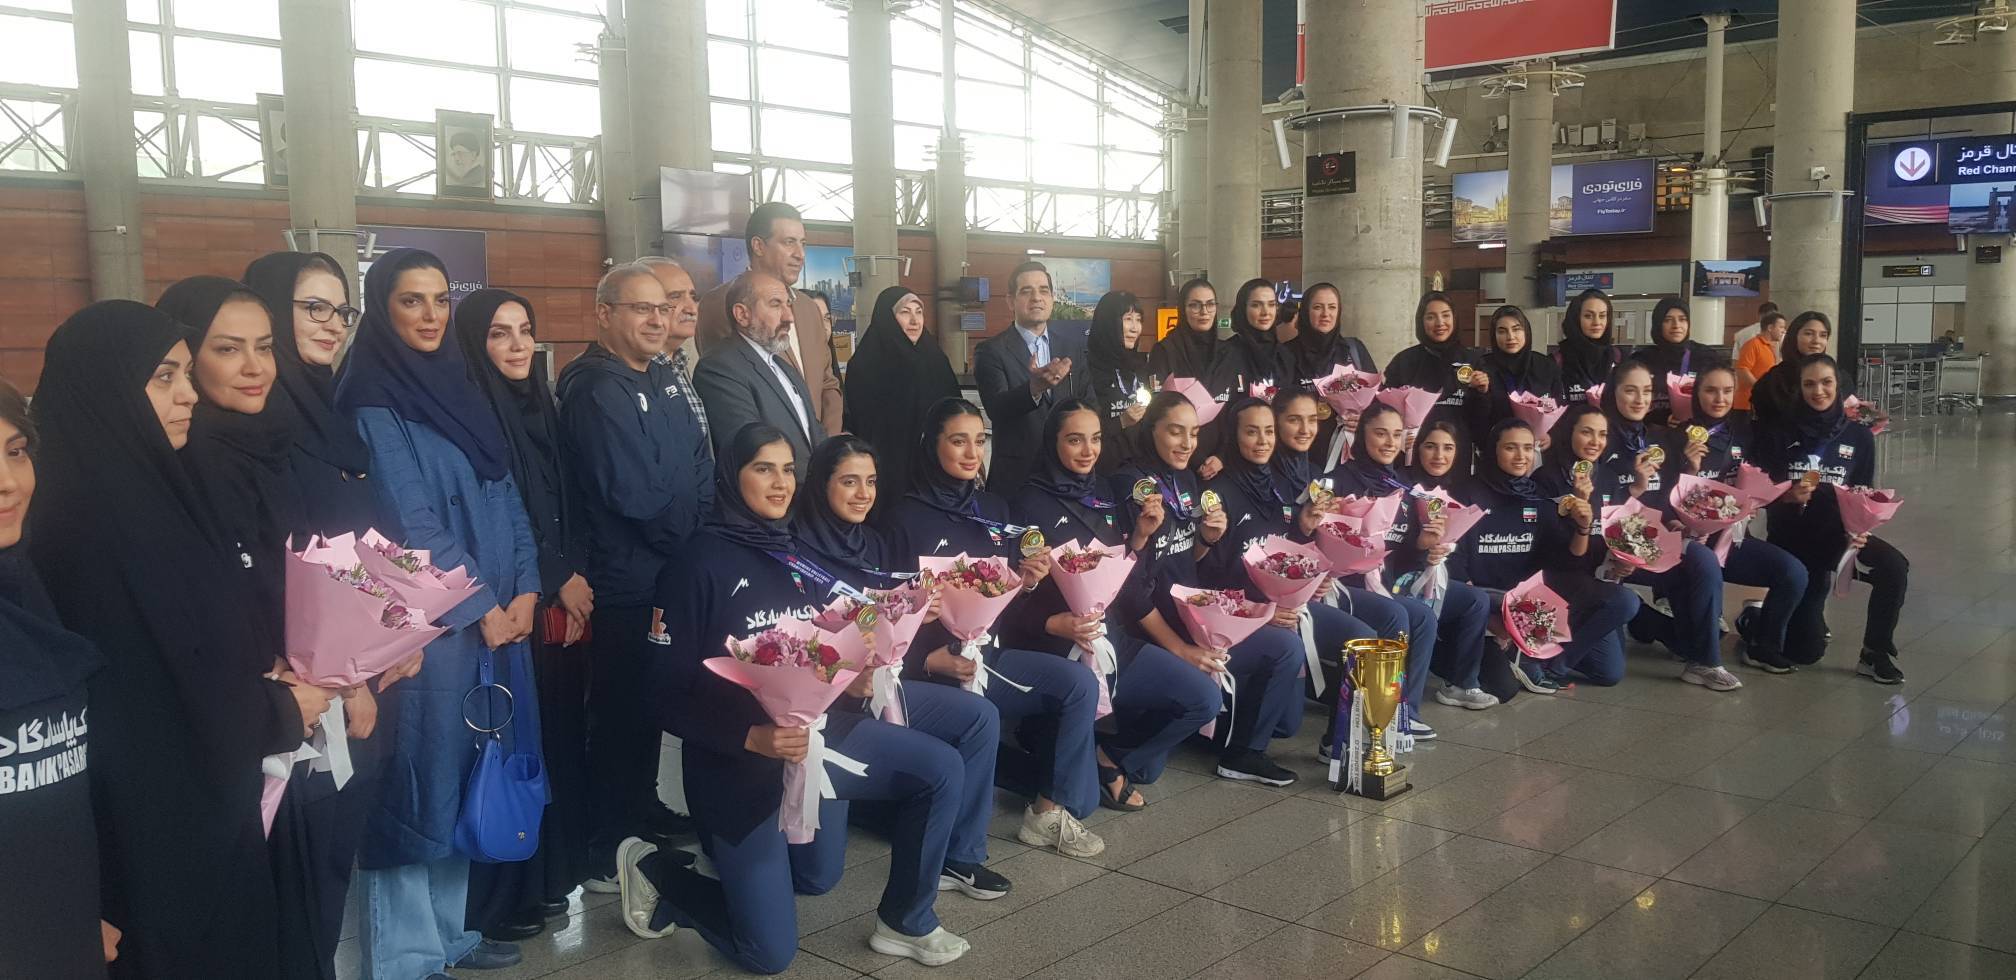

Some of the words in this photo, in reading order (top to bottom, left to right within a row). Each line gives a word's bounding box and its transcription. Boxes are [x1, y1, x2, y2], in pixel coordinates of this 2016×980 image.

[1957, 145, 1992, 162] قرمز
[1958, 166, 1980, 176] Red
[1983, 164, 2016, 174] Chan
[0, 755, 60, 795] BANK
[57, 741, 88, 781] PASAR
